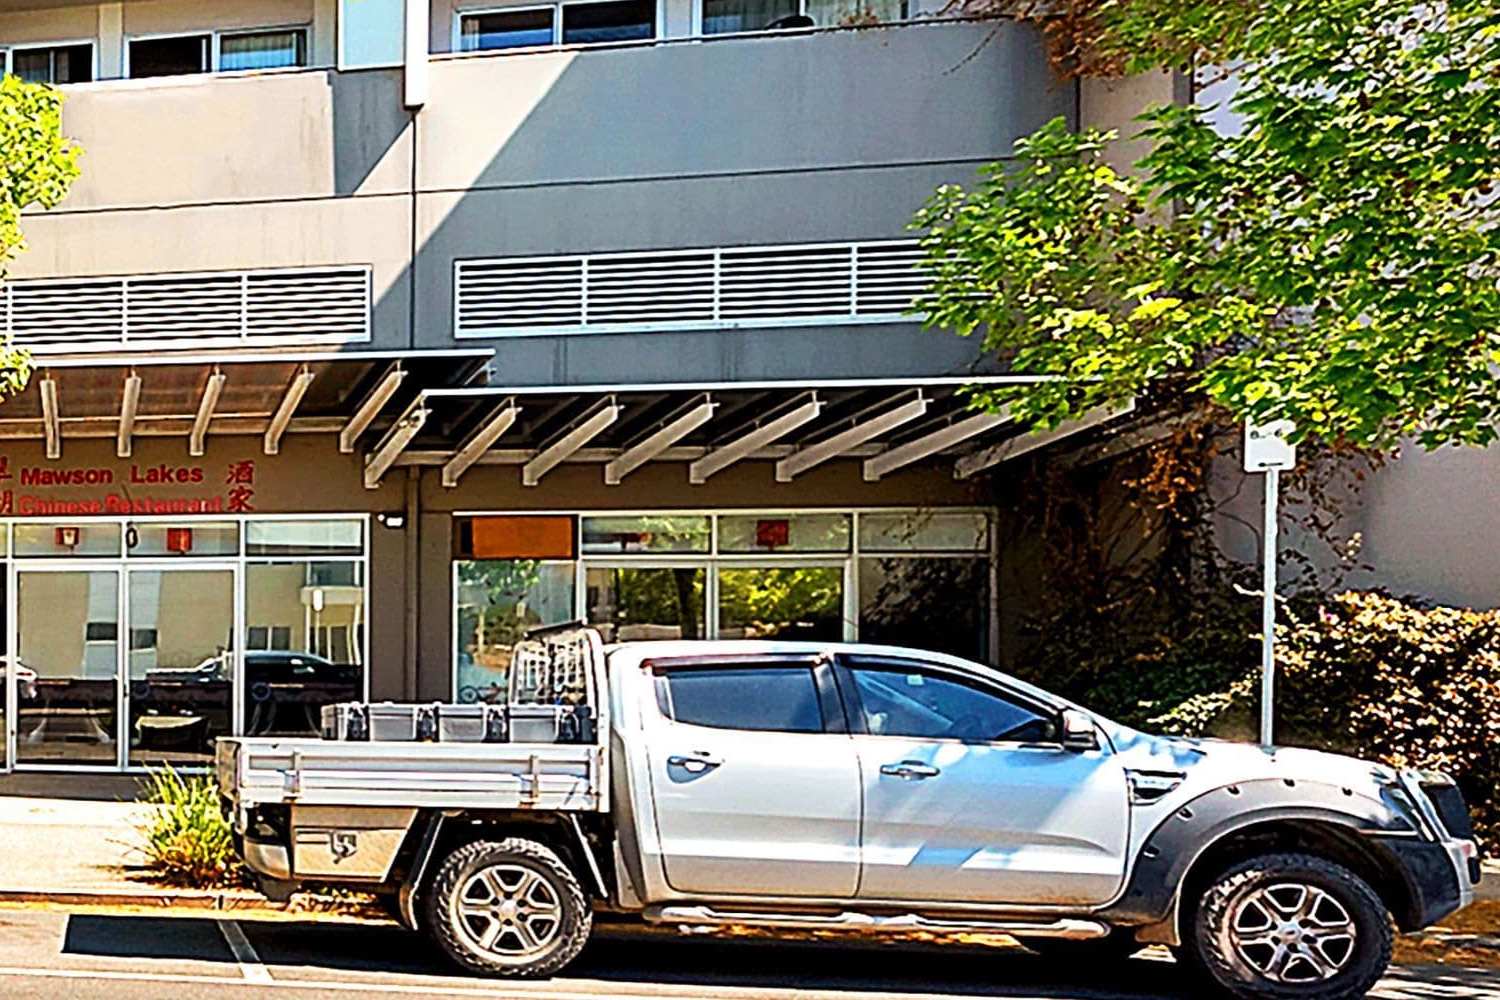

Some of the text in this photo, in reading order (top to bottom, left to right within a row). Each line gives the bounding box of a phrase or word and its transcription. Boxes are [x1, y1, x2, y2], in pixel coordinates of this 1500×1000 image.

[20, 463, 204, 486] Mawson Lakes
[19, 493, 223, 515] Chinese Restaurant
